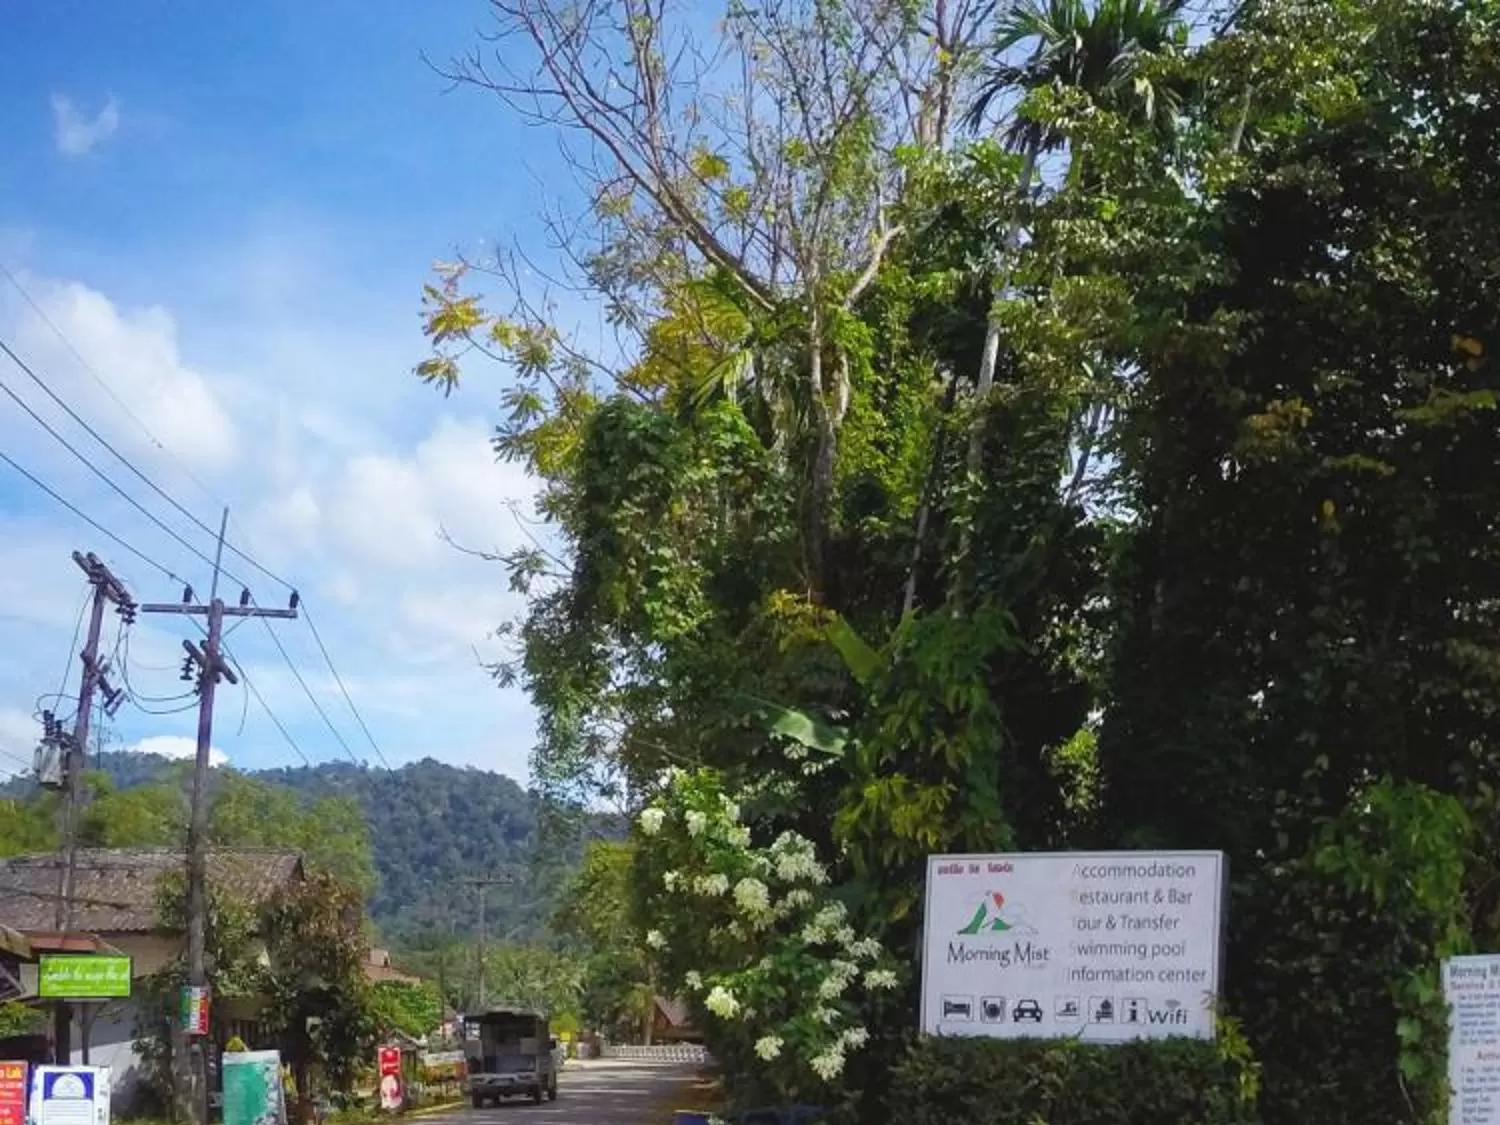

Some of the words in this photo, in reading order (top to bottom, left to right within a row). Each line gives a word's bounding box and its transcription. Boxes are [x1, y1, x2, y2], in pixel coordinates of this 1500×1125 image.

[1153, 888, 1165, 904] &
[1167, 887, 1193, 904] Bar
[1105, 913, 1117, 930] &
[1120, 914, 1181, 931] Transfer
[946, 941, 1011, 968] Morning
[1013, 941, 1051, 966] Mist
[1151, 940, 1186, 961] pool
[1158, 967, 1207, 984] center
